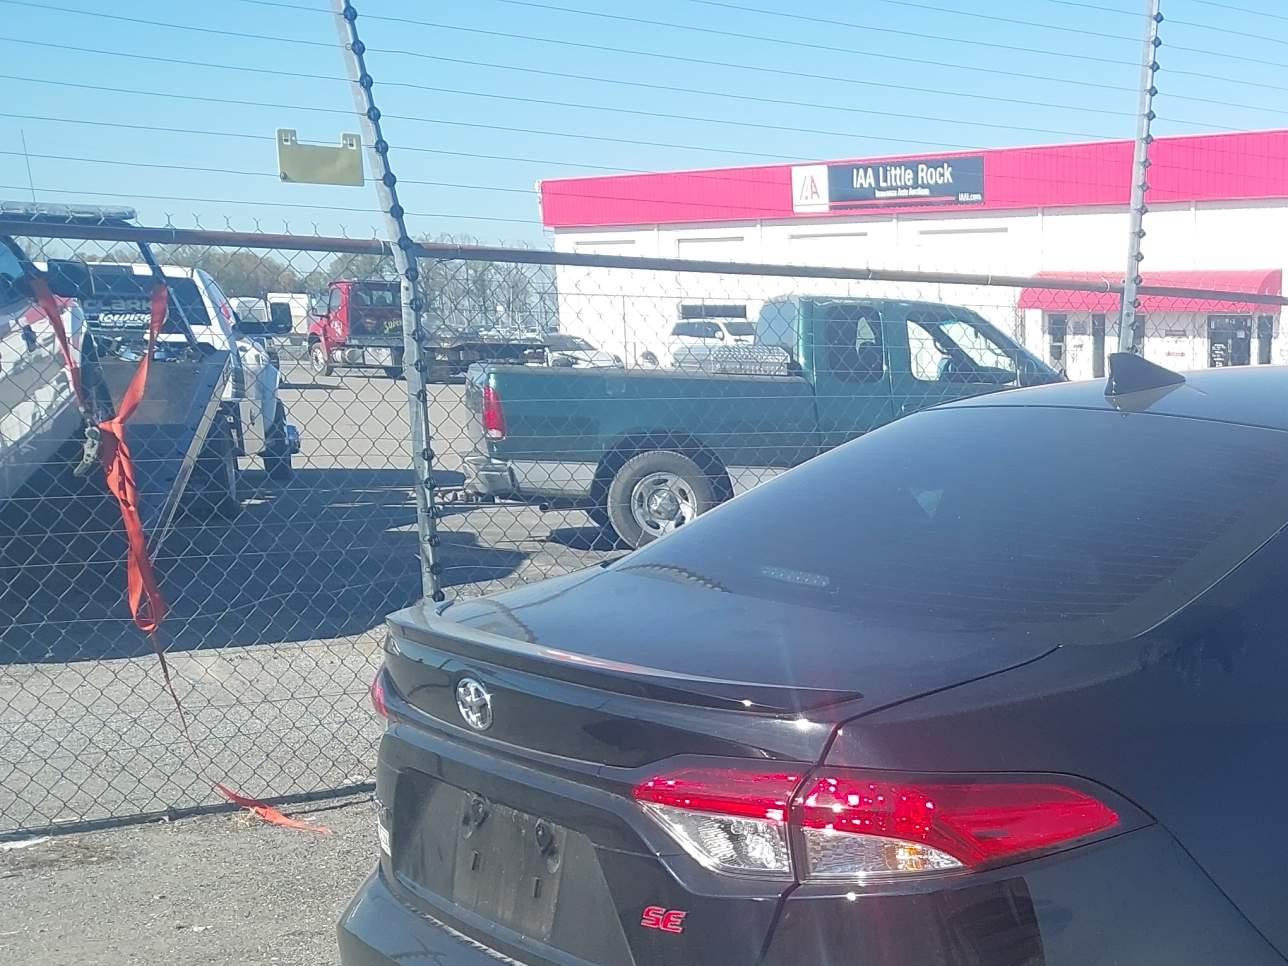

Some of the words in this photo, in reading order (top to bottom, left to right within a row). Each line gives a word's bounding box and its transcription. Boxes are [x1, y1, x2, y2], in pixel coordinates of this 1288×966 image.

[853, 167, 875, 188] IAA
[879, 165, 914, 187] Little
[918, 163, 953, 185] Rock
[640, 905, 688, 934] SE
